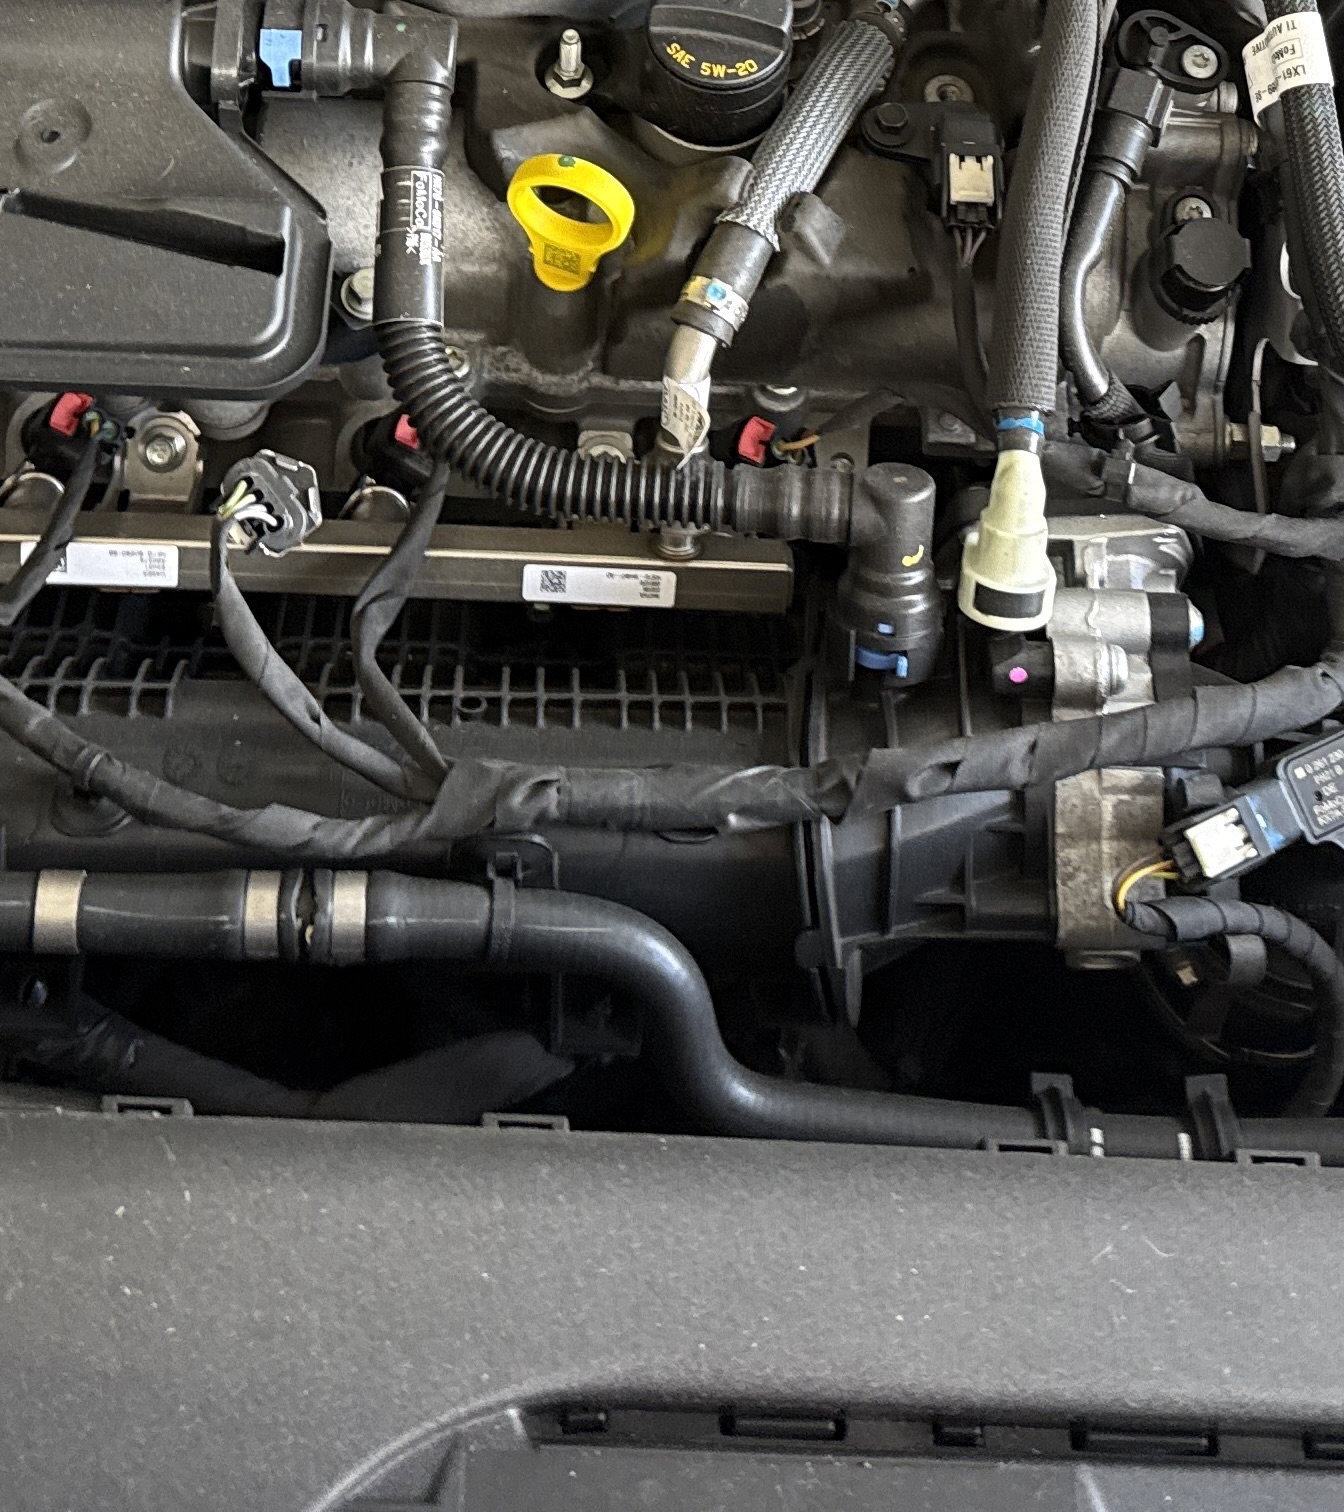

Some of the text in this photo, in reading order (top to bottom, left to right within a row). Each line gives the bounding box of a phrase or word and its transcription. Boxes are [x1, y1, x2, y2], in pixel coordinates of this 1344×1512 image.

[665, 42, 758, 78] SAE 5W-20
[414, 173, 427, 226] FoMoCo
